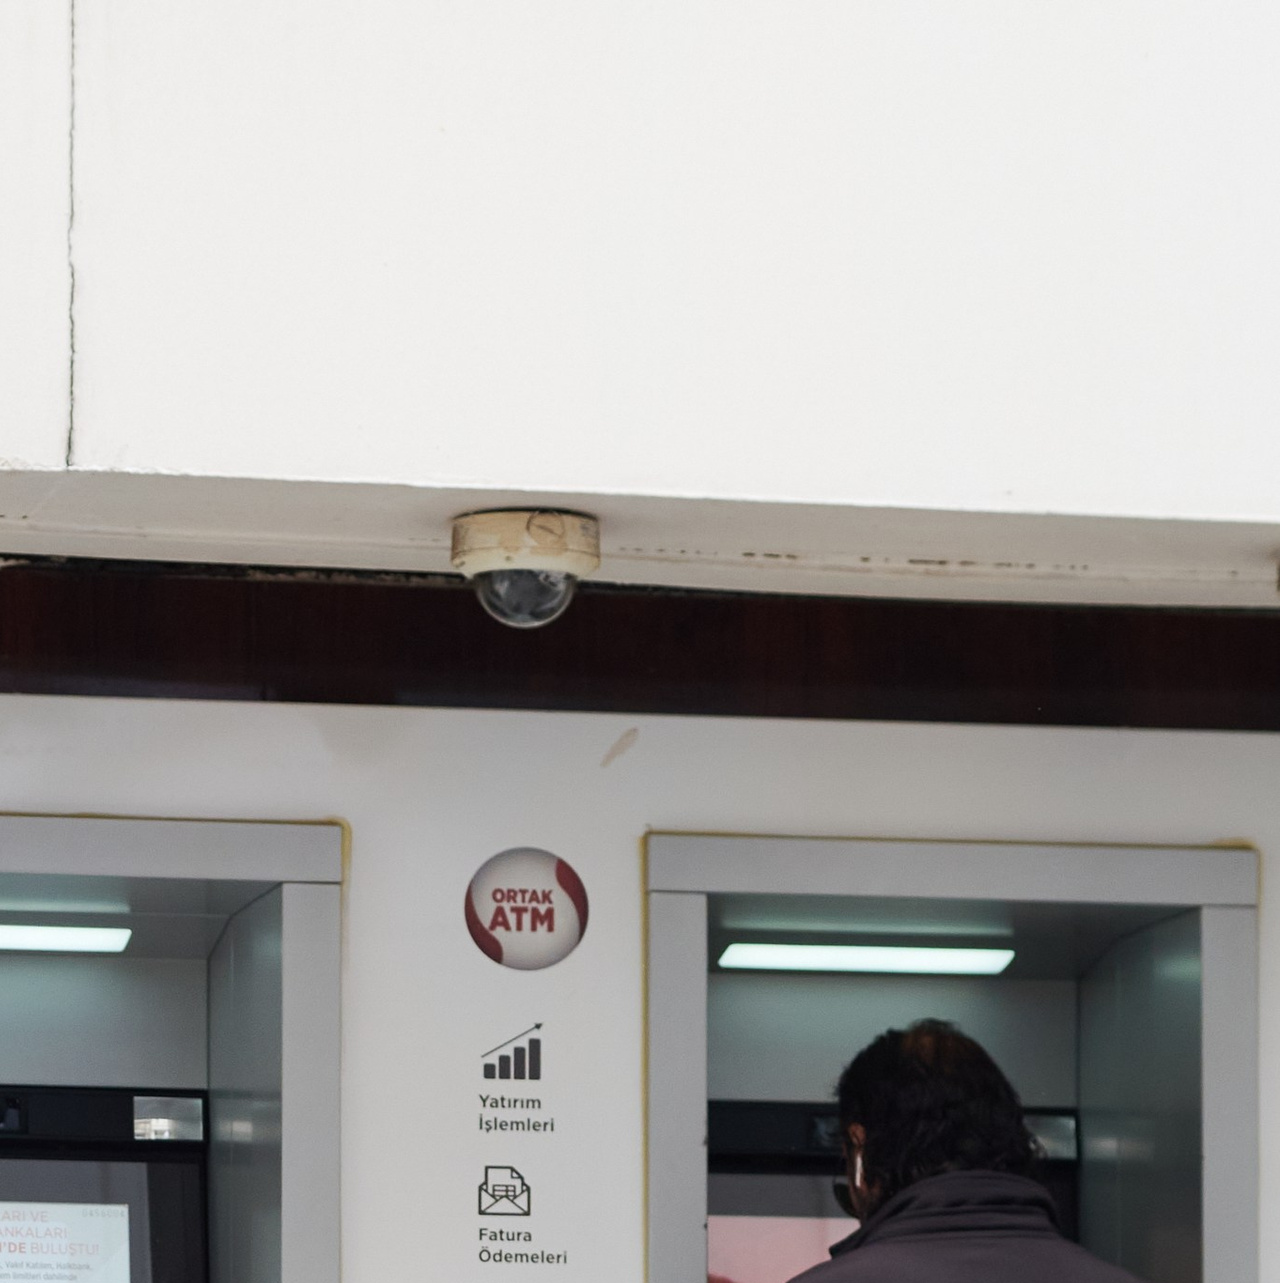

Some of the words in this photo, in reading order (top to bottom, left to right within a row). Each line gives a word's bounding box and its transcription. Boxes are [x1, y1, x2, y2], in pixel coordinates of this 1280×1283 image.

[491, 887, 554, 905] ORTAK
[488, 905, 555, 933] ATM
[478, 1093, 542, 1109] Yatırım
[478, 1113, 555, 1133] İşlemleri
[29, 1210, 50, 1222] VE
[478, 1227, 532, 1242] Fatura
[30, 1242, 99, 1257] BULUŞTU!
[478, 1246, 568, 1264] Ödemeleri
